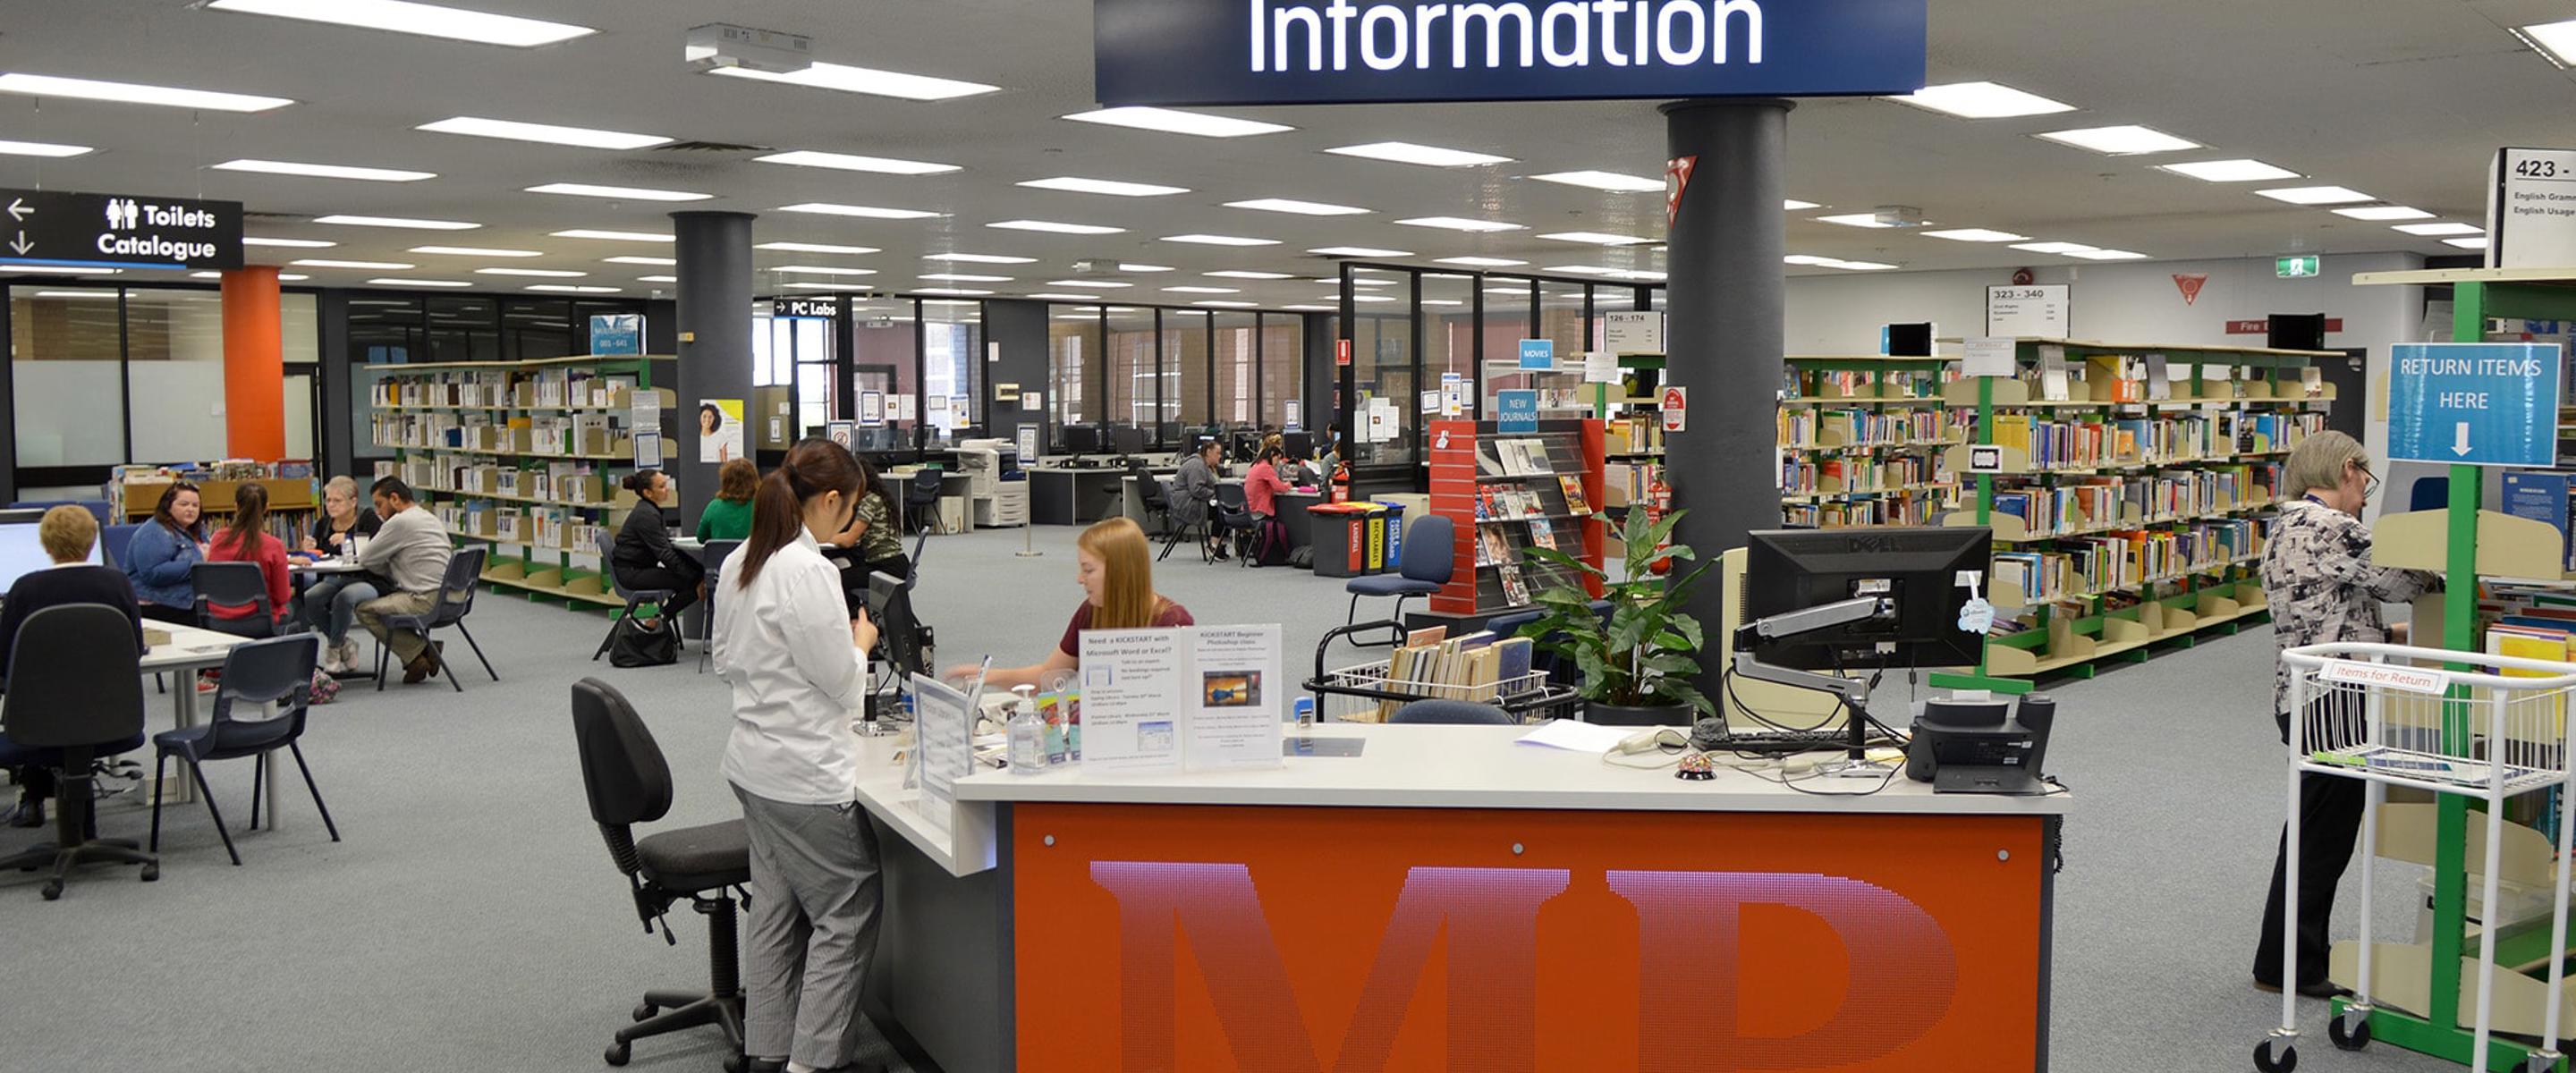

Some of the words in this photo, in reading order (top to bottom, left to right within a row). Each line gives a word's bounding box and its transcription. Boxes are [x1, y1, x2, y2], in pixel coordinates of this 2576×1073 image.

[1250, 0, 1764, 72] Information
[2516, 160, 2555, 177] 423
[2514, 192, 2546, 201] English
[143, 205, 216, 228] Toilets
[2513, 207, 2545, 215] English
[2547, 207, 2575, 216] Usage
[97, 233, 216, 261] Catalogue
[1994, 291, 2014, 299] 323
[2024, 290, 2044, 298] 340
[792, 301, 808, 315] PC
[810, 302, 837, 317] Labs
[2241, 322, 2259, 331] Fire
[1524, 350, 1549, 359] MOVIES
[2401, 359, 2471, 376] RETURN
[2478, 359, 2542, 376] ITEMS
[1509, 399, 1528, 409] NEW
[2439, 392, 2489, 410] HERE
[1500, 411, 1536, 422] JOURNALS
[1848, 537, 1901, 553] DELL
[1115, 636, 1152, 644] KICKSTART
[1086, 649, 1119, 657] Microsoft
[1150, 646, 1172, 655] Excel?
[2336, 666, 2368, 679] Items
[2370, 670, 2388, 680] for
[2390, 672, 2431, 687] Return
